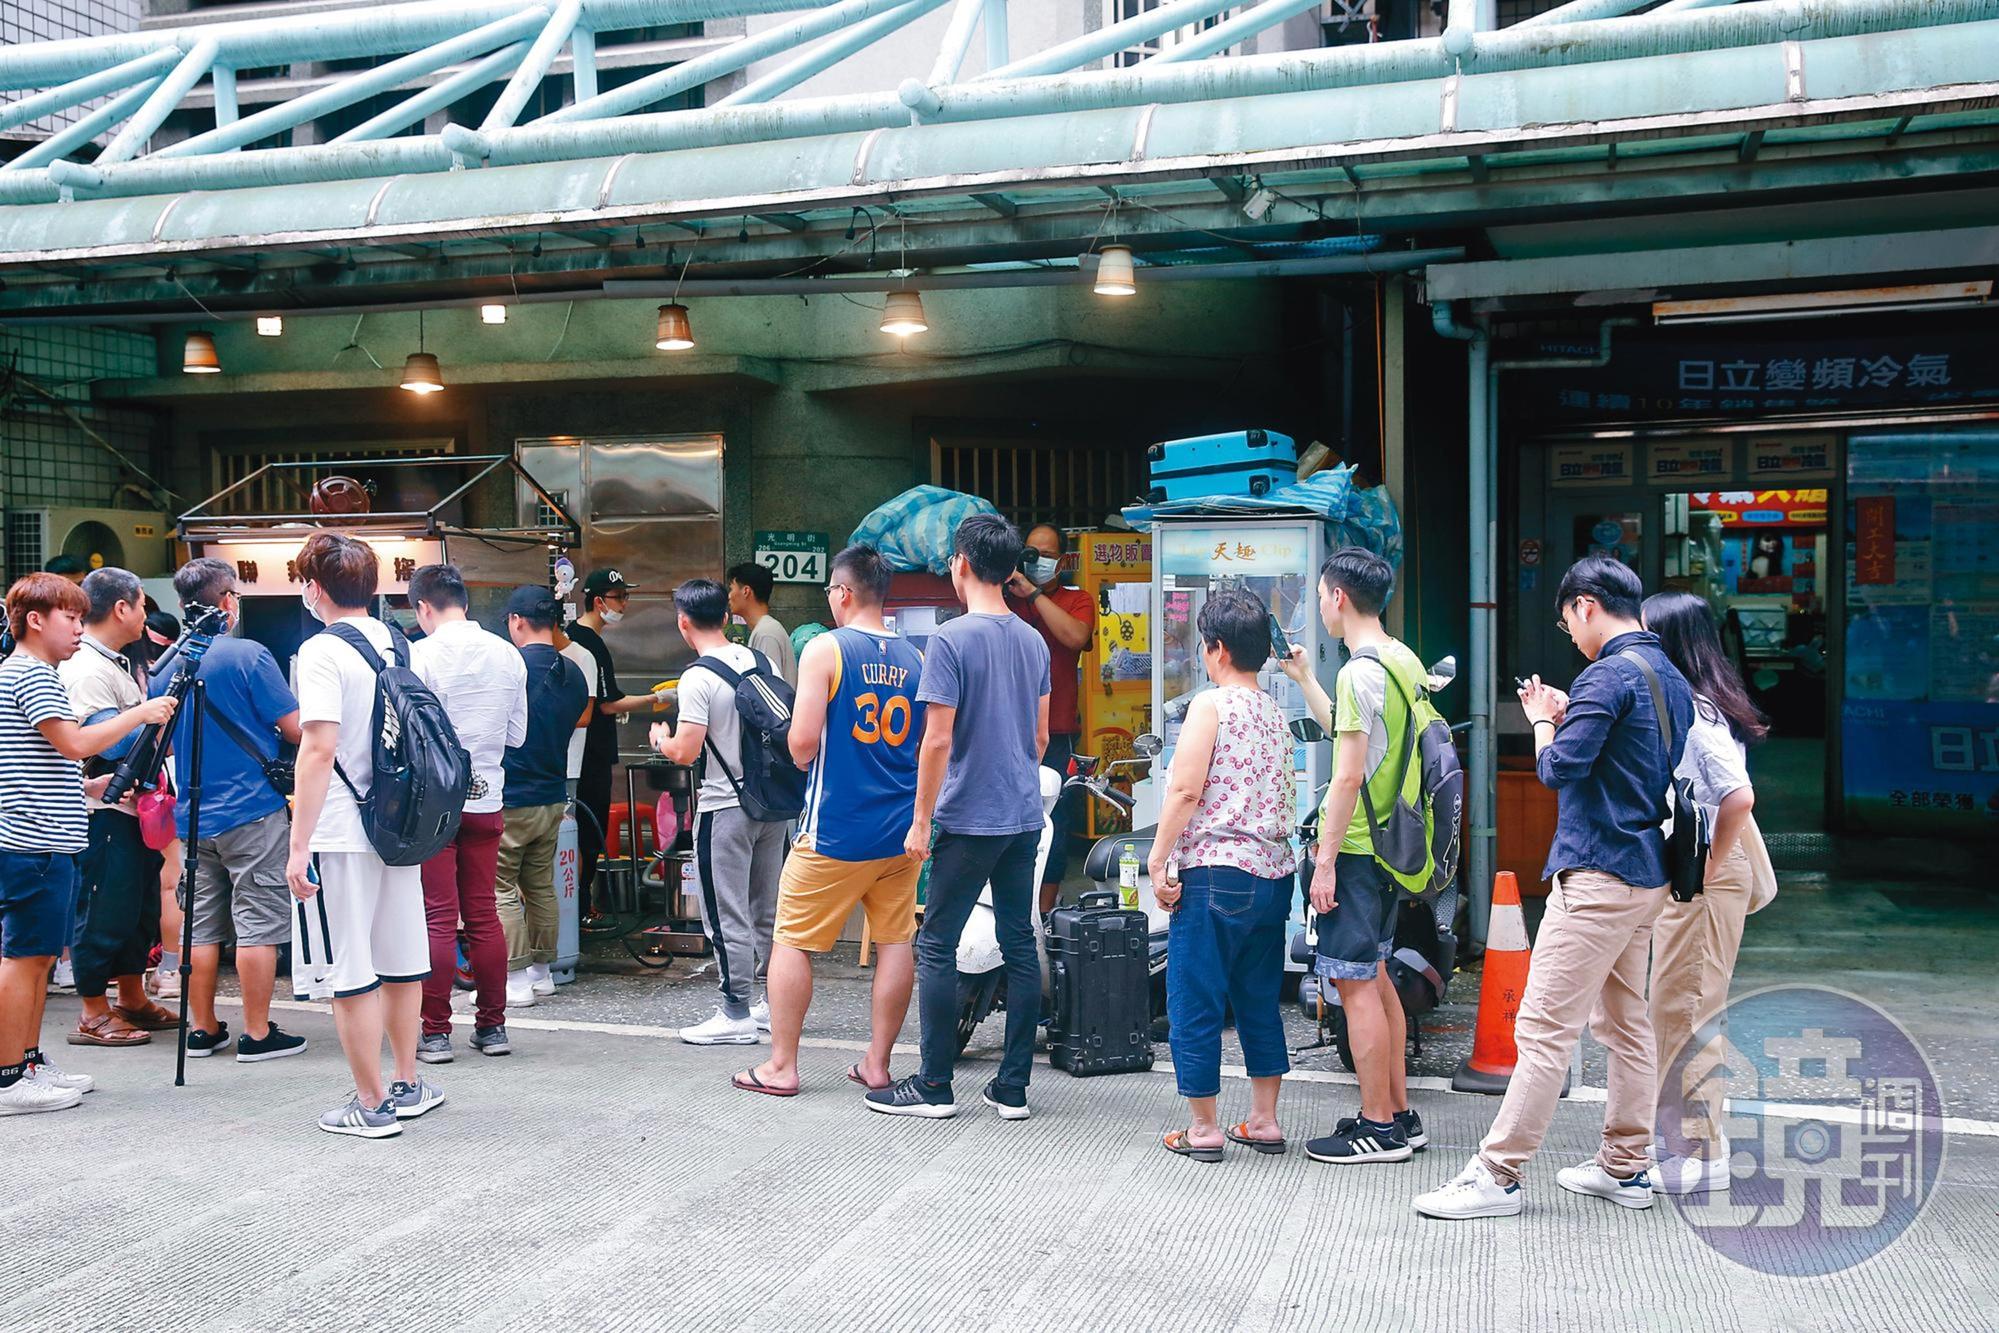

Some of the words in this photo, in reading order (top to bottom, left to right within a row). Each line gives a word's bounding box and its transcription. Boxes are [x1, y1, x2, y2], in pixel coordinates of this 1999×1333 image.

[1537, 344, 1600, 354] HITACH
[1679, 353, 1951, 392] 日立變頻冷氣
[767, 532, 816, 542] 光明街
[1861, 503, 1887, 581] 開工大吉
[765, 554, 819, 579] 204
[862, 663, 908, 688] CURRY
[852, 692, 911, 747] 30
[1, 1068, 19, 1076] 86
